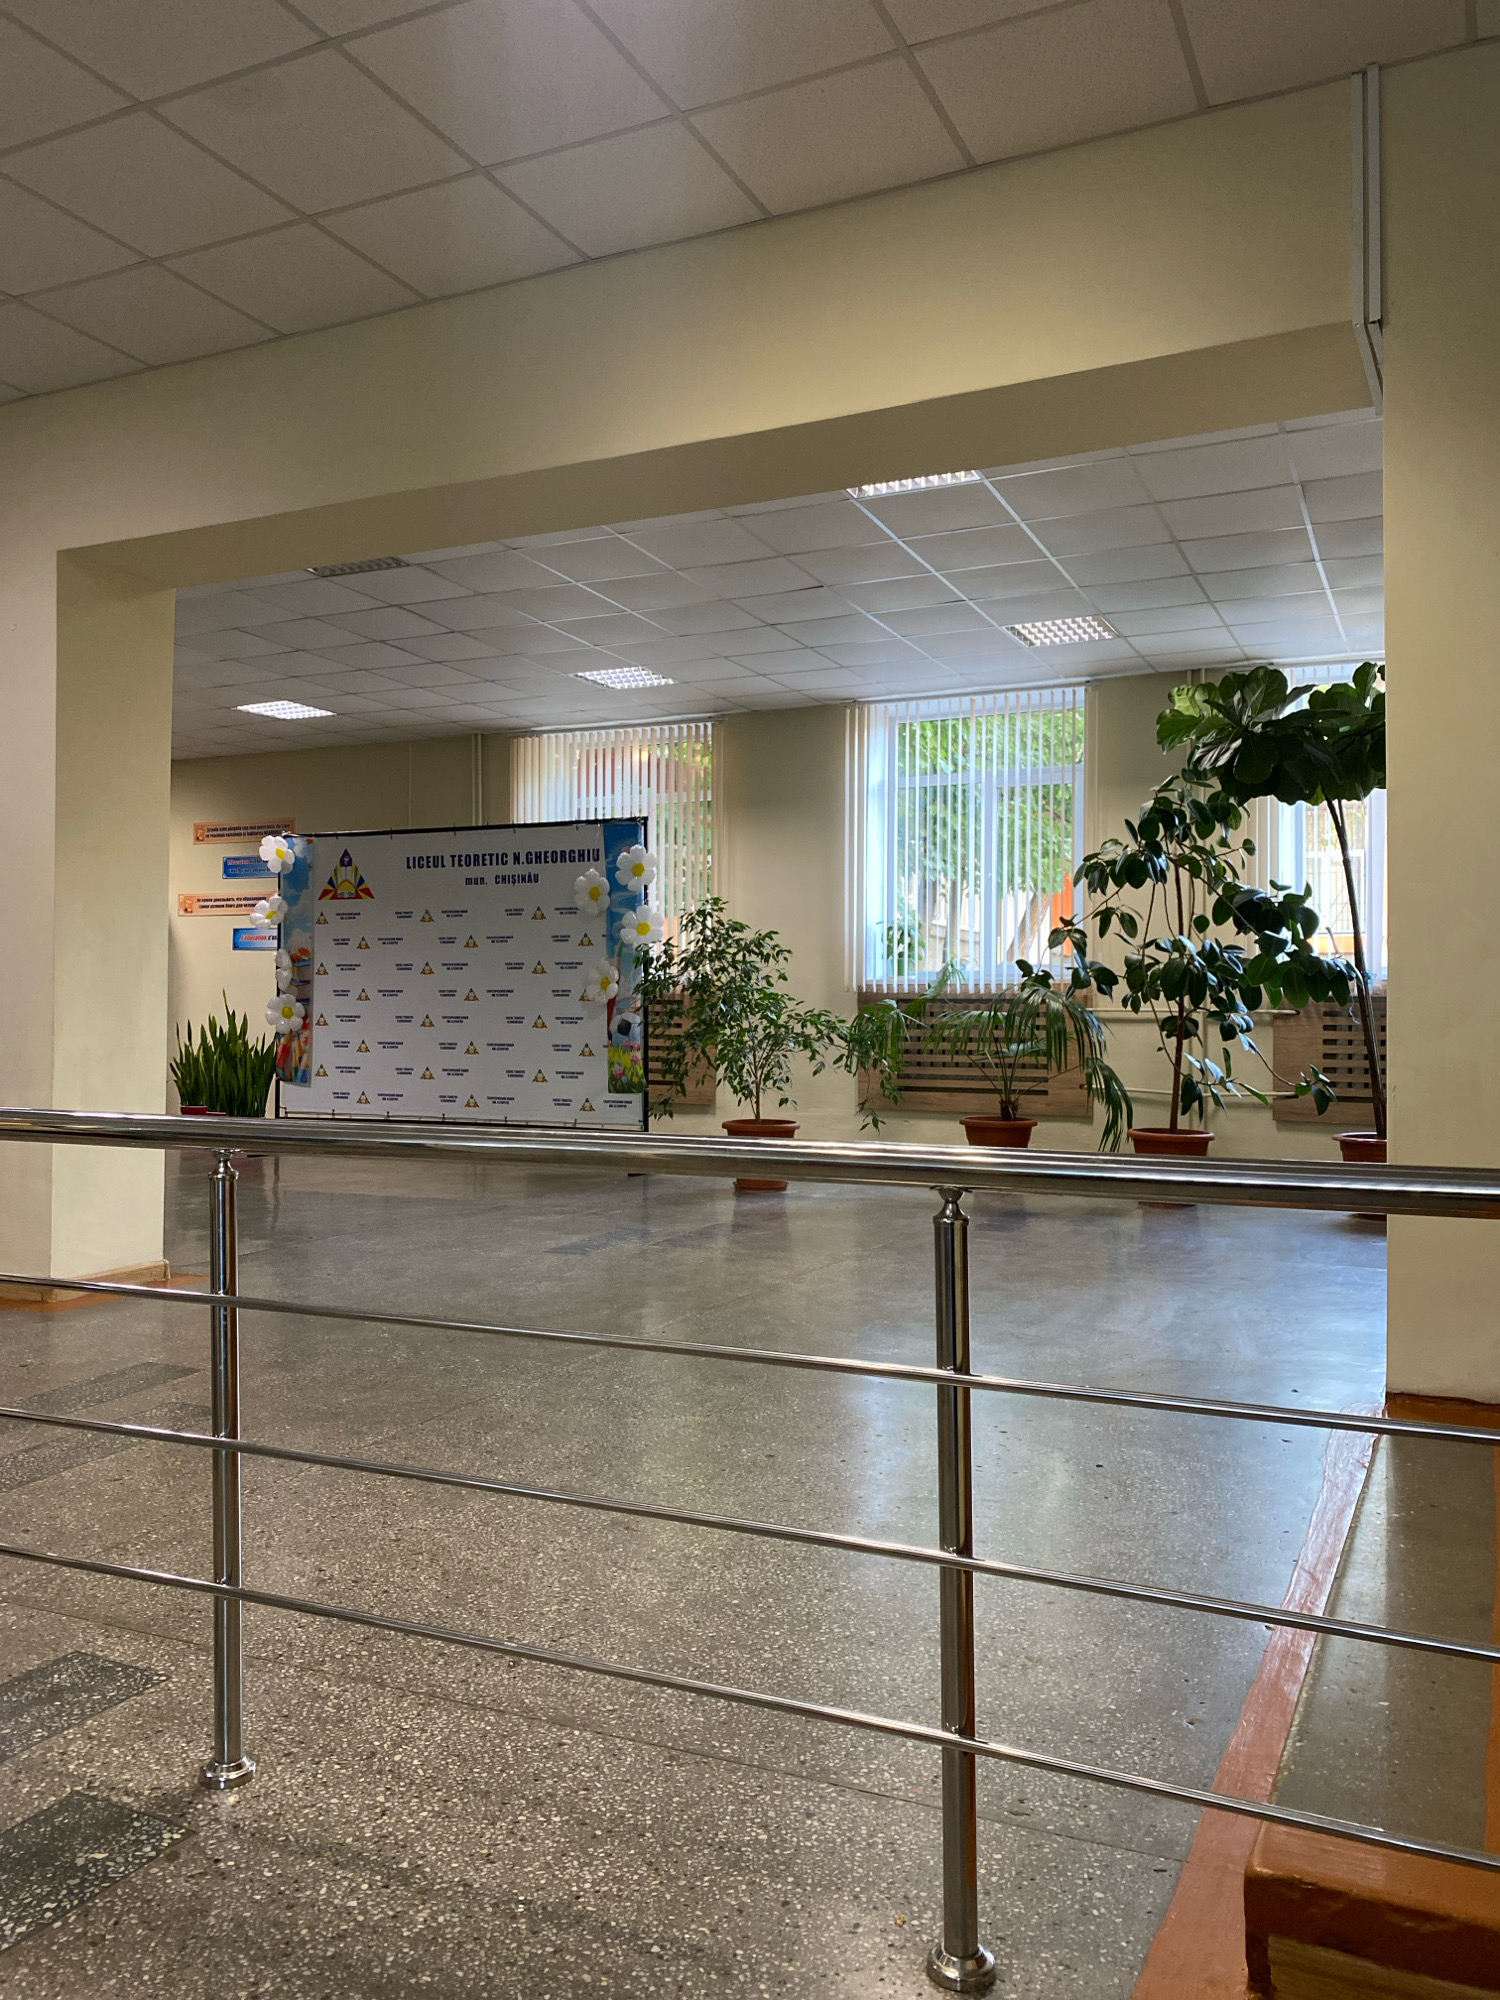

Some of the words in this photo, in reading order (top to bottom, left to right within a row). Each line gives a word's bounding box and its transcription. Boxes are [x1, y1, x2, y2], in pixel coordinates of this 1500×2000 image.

[406, 855, 446, 870] LICEUL
[450, 852, 509, 868] TEORETIC
[512, 848, 600, 866] N.GHEORGHIU
[464, 876, 488, 886] mun.
